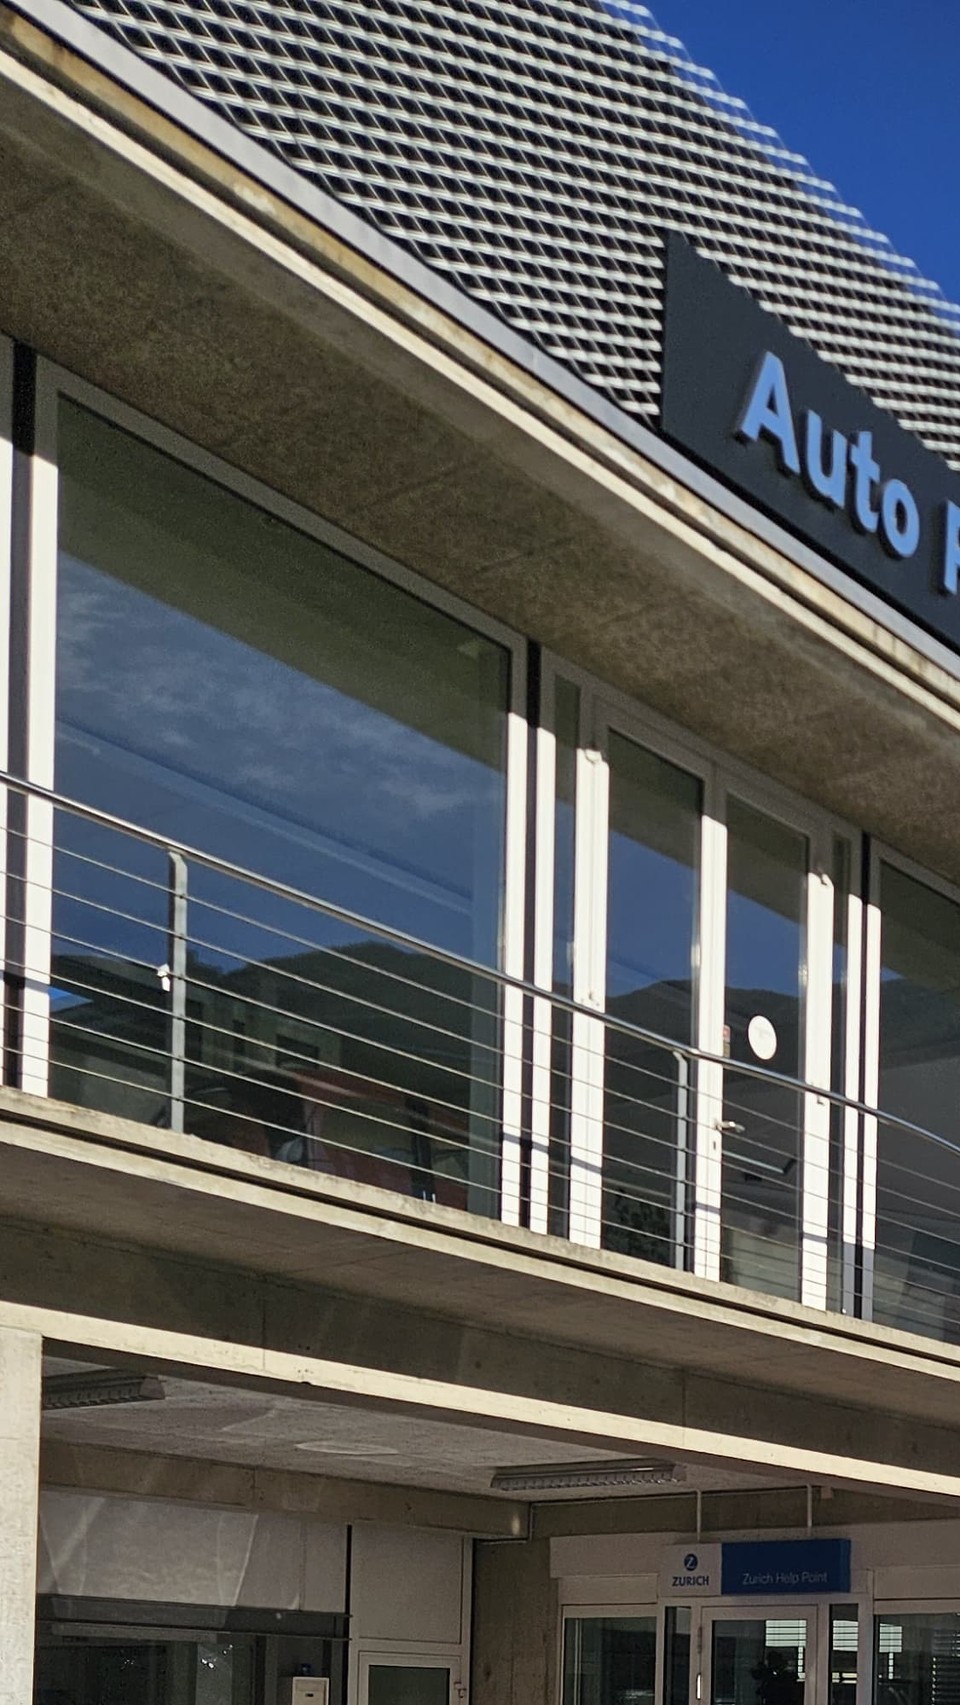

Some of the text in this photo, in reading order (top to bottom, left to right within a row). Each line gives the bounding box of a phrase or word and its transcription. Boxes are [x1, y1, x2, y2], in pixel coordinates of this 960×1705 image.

[737, 351, 921, 559] Auto
[672, 1576, 710, 1587] ZURICH
[742, 1571, 828, 1585] Zurich Help Point
